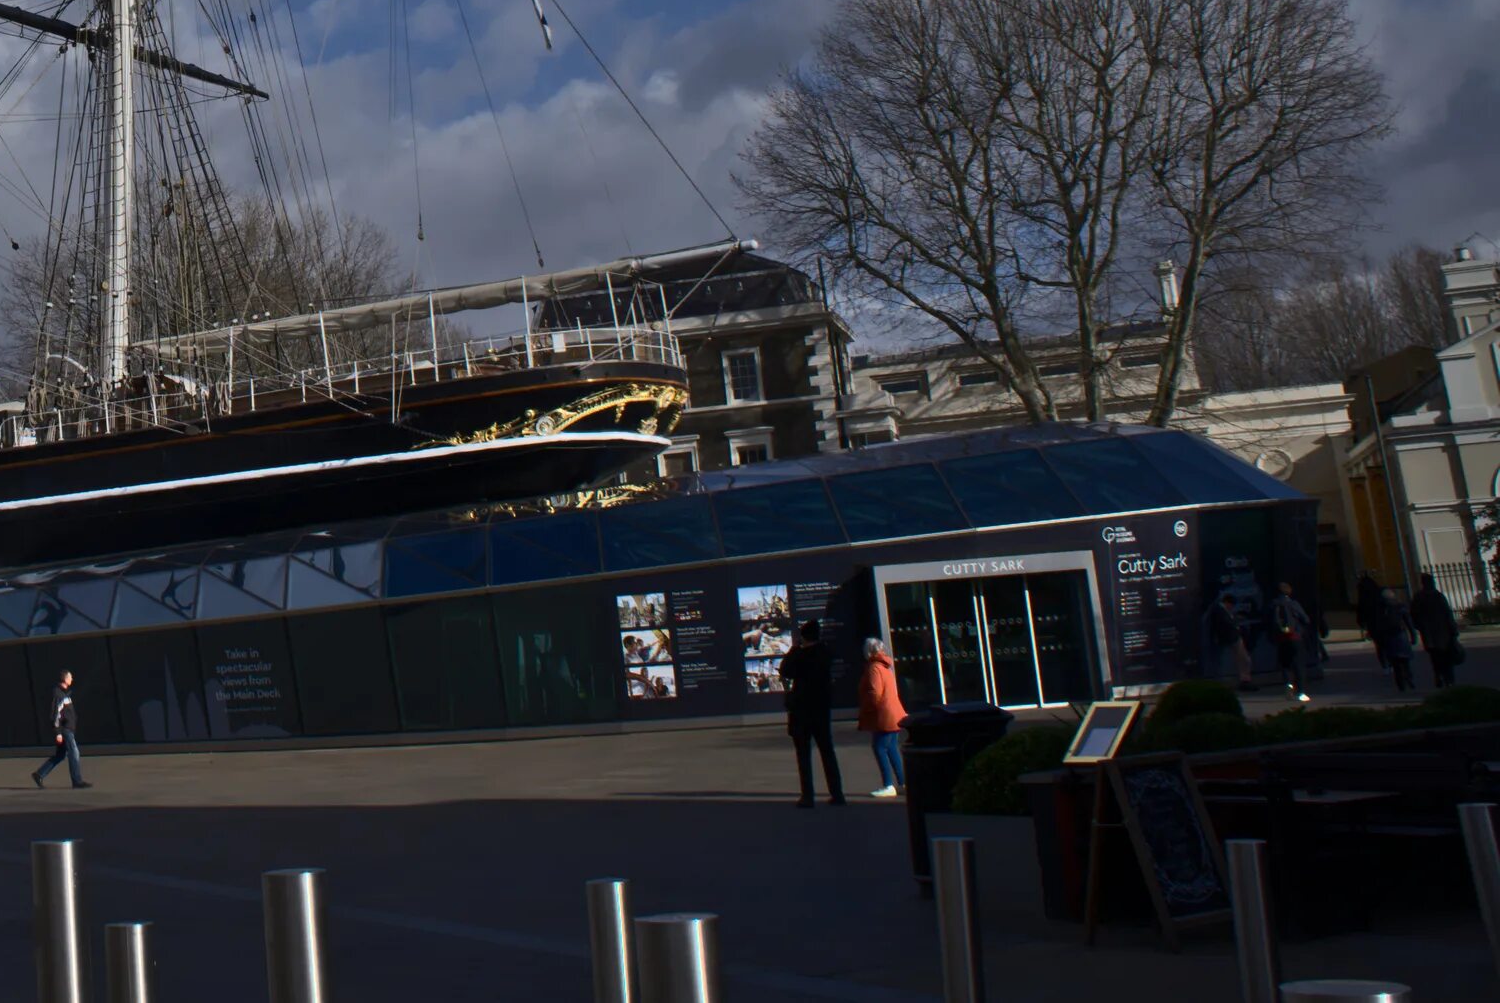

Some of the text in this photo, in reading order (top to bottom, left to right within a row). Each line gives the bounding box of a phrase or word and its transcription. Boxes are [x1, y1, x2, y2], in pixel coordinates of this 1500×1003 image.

[943, 559, 1025, 576] CUTTY SARK
[1117, 552, 1189, 575] Cutty Sark
[224, 647, 260, 659] Take in
[215, 661, 272, 676] spectacular
[221, 674, 272, 687] views from
[215, 690, 231, 702] the
[233, 688, 256, 699] Main
